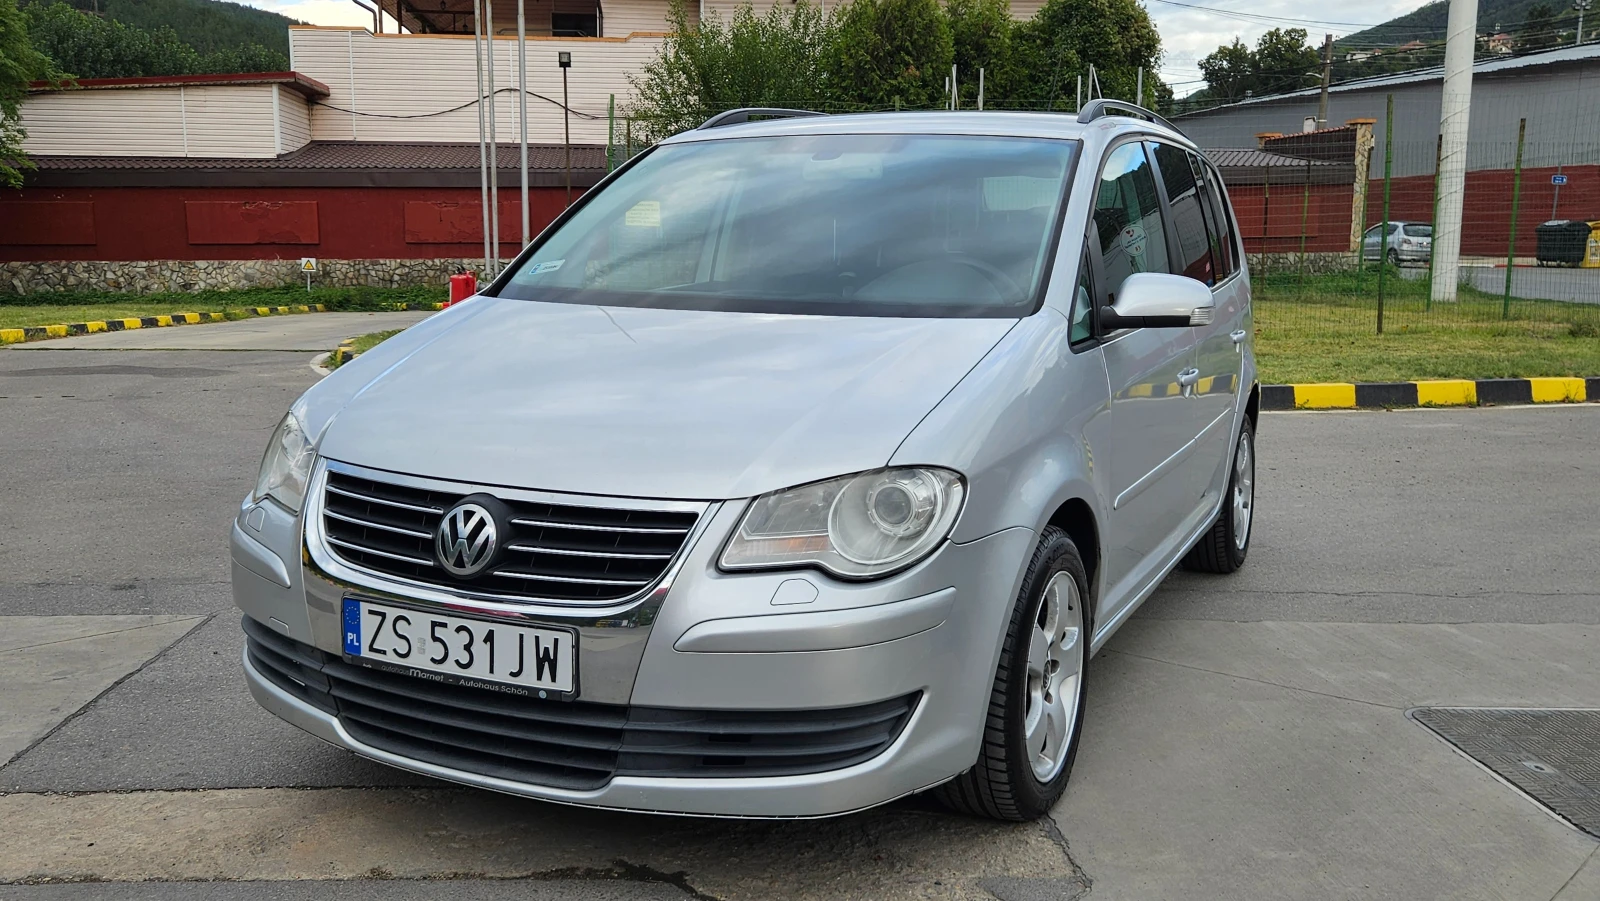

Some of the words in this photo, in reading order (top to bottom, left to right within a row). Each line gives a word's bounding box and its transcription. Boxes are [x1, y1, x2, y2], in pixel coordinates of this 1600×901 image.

[438, 504, 496, 575] VW
[347, 632, 360, 646] PL
[459, 679, 499, 691] Autohaus
[500, 685, 528, 696] Schön
